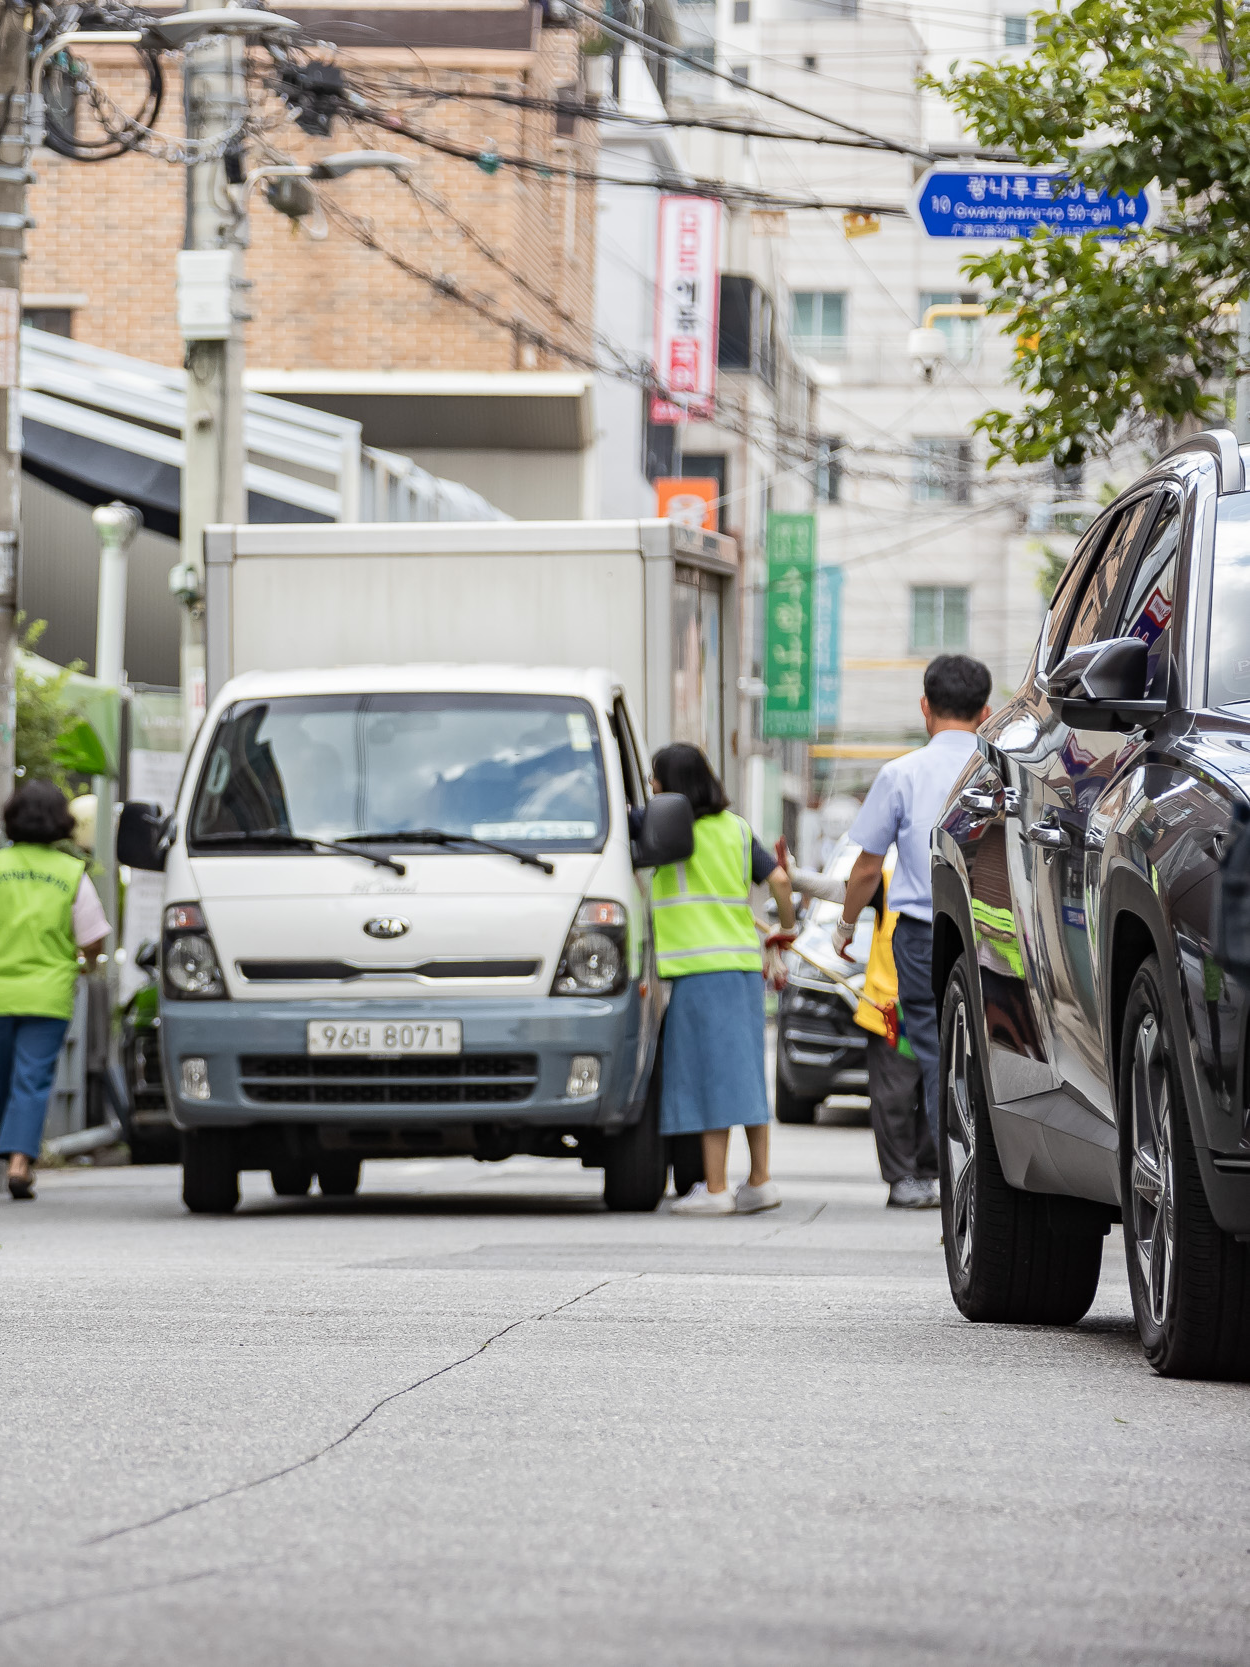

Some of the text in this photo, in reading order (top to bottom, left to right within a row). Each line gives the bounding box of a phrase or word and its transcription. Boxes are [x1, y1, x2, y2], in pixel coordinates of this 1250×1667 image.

[931, 195, 952, 214] 10
[953, 202, 1064, 222] Gwangnaru-ro
[1117, 198, 1136, 217] 14
[383, 1025, 445, 1049] 8071
